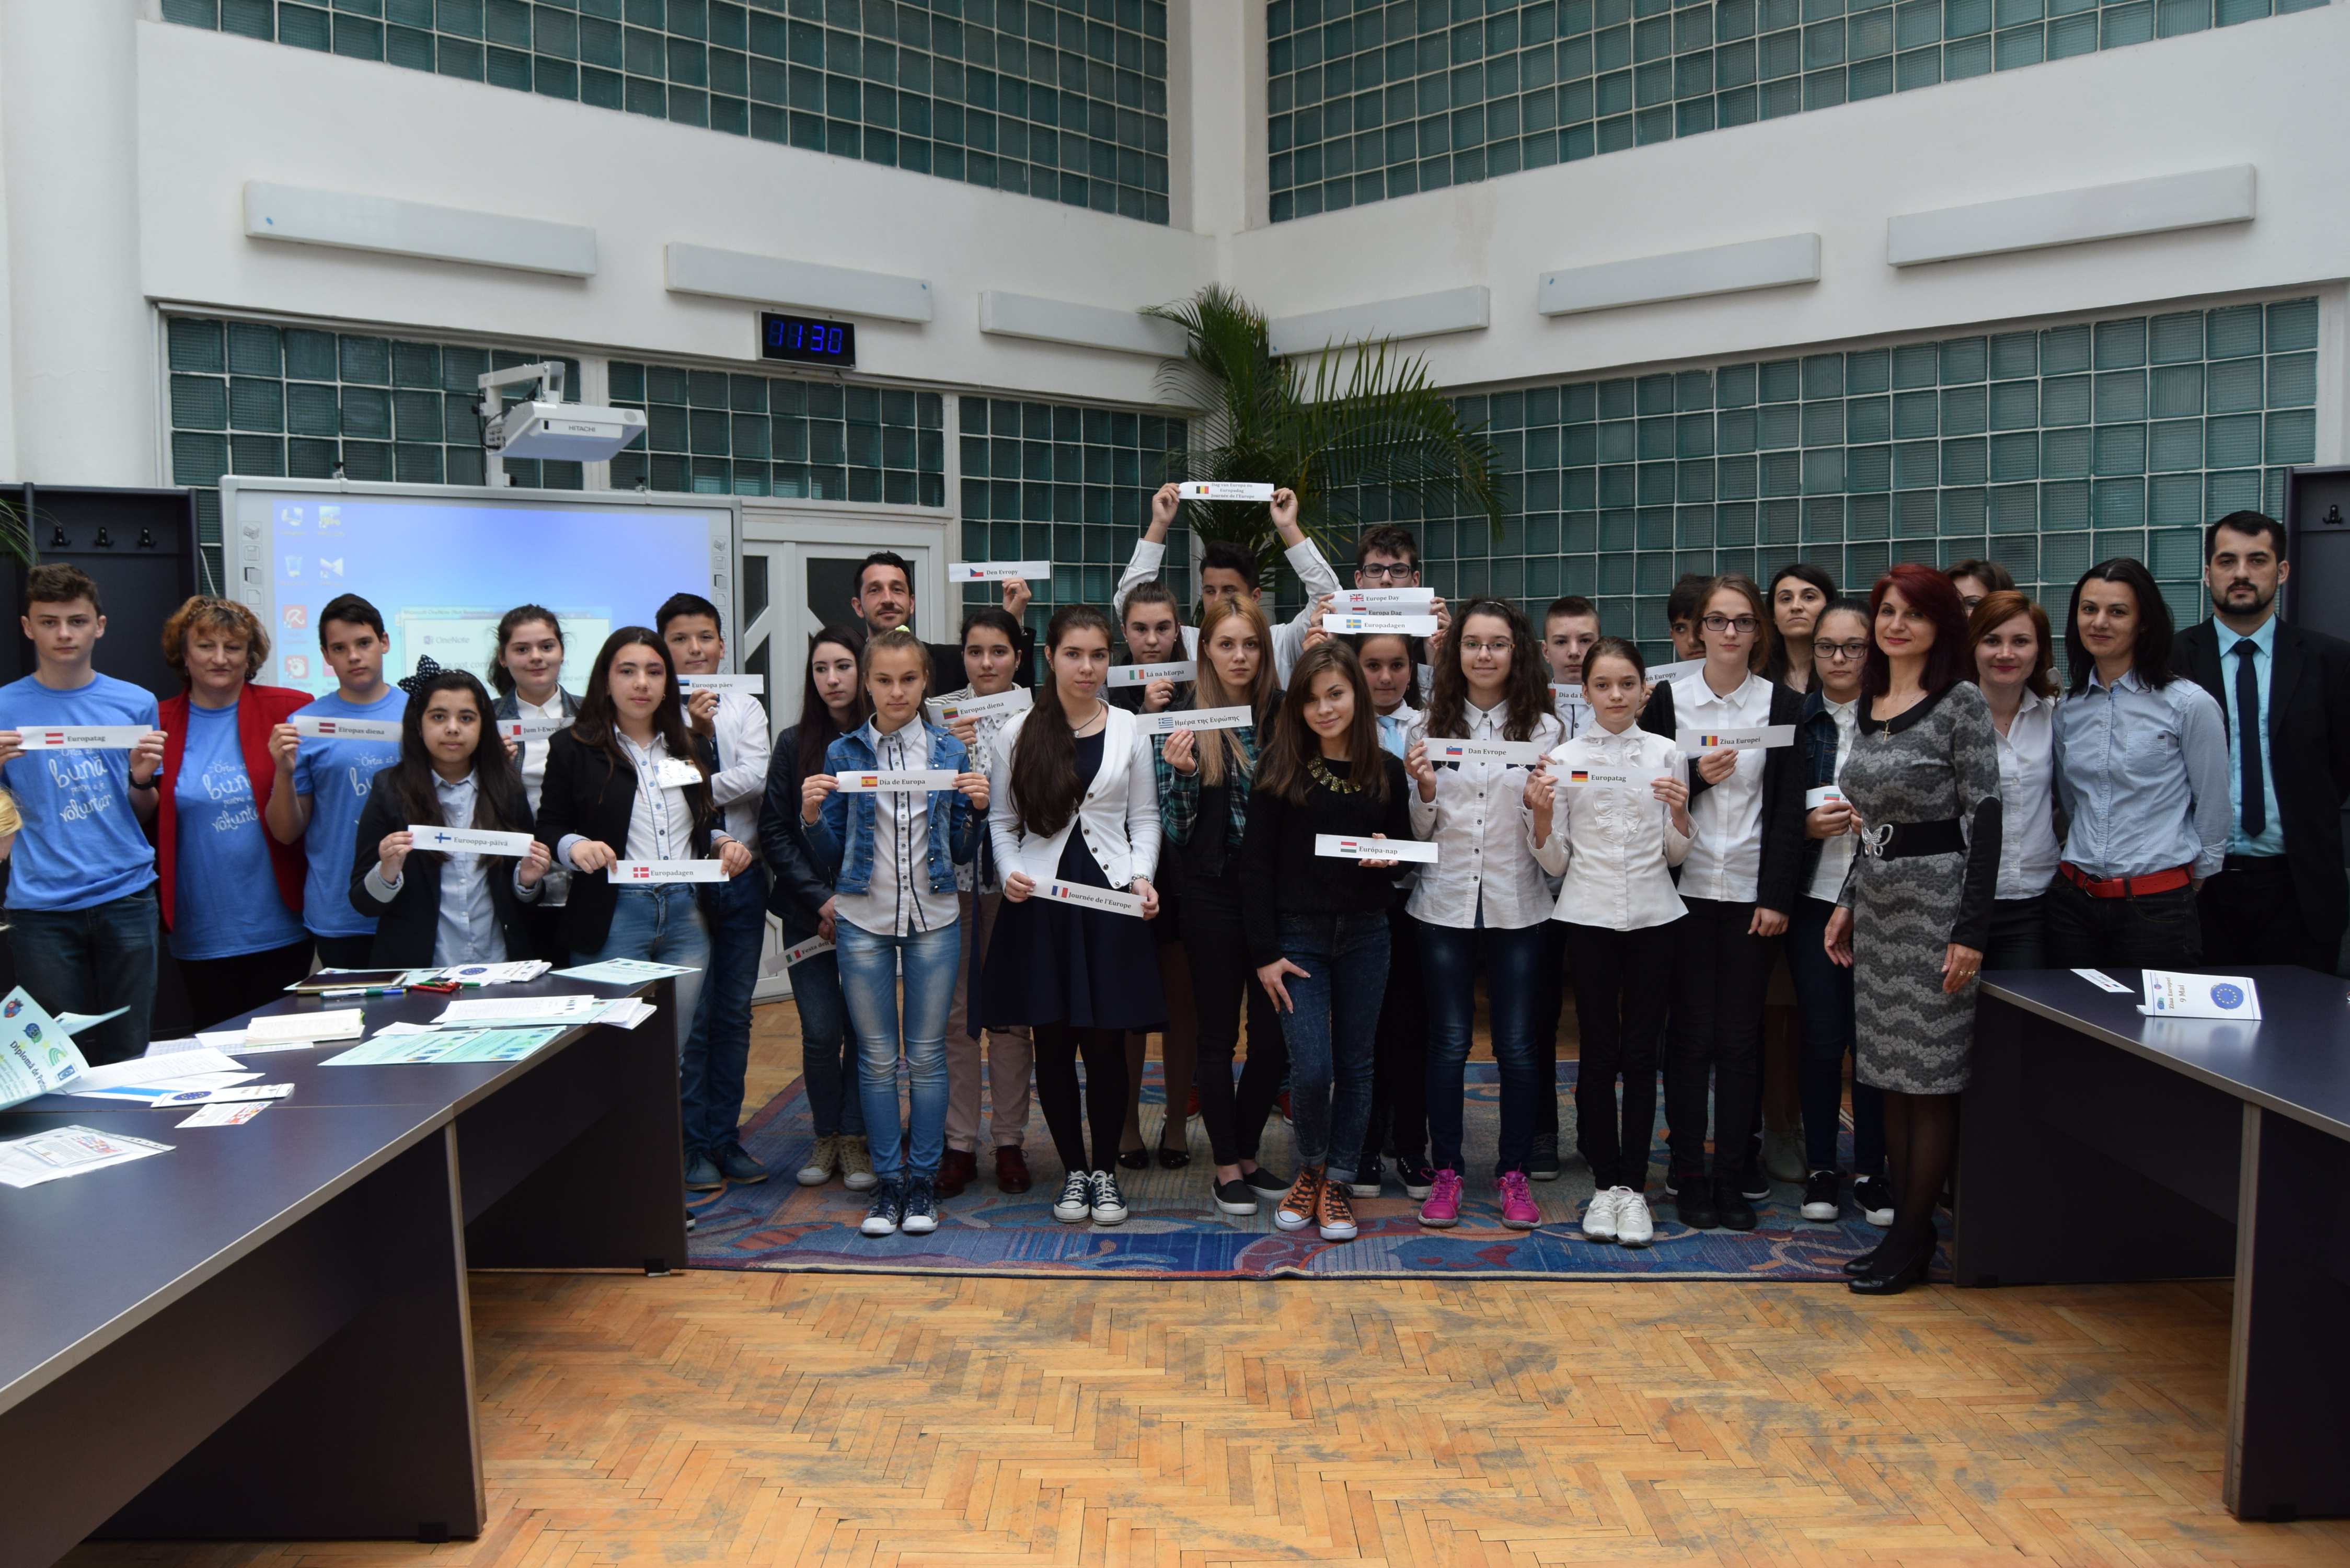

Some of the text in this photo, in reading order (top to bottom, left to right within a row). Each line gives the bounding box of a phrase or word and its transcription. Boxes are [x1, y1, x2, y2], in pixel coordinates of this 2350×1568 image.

[1654, 672, 1677, 681] Europy
[960, 701, 1004, 716] Europos diena
[1209, 715, 1240, 724] Ευρώπης
[339, 726, 364, 734] Eiropas
[1736, 736, 1761, 745] Europei
[49, 755, 108, 788] bună
[1591, 774, 1627, 782] Europatag
[202, 774, 251, 800] bun
[60, 794, 112, 822] voluntar
[454, 837, 508, 847] Eurooppa-päivä
[1358, 845, 1398, 855] Európa-nap
[650, 870, 694, 878] Europadagen
[1068, 892, 1094, 903] Journée
[1104, 898, 1132, 910] l'Europe
[801, 944, 817, 955] Festa
[2165, 977, 2174, 997] Europei
[2177, 984, 2187, 997] Mai
[32, 1067, 40, 1078] de
